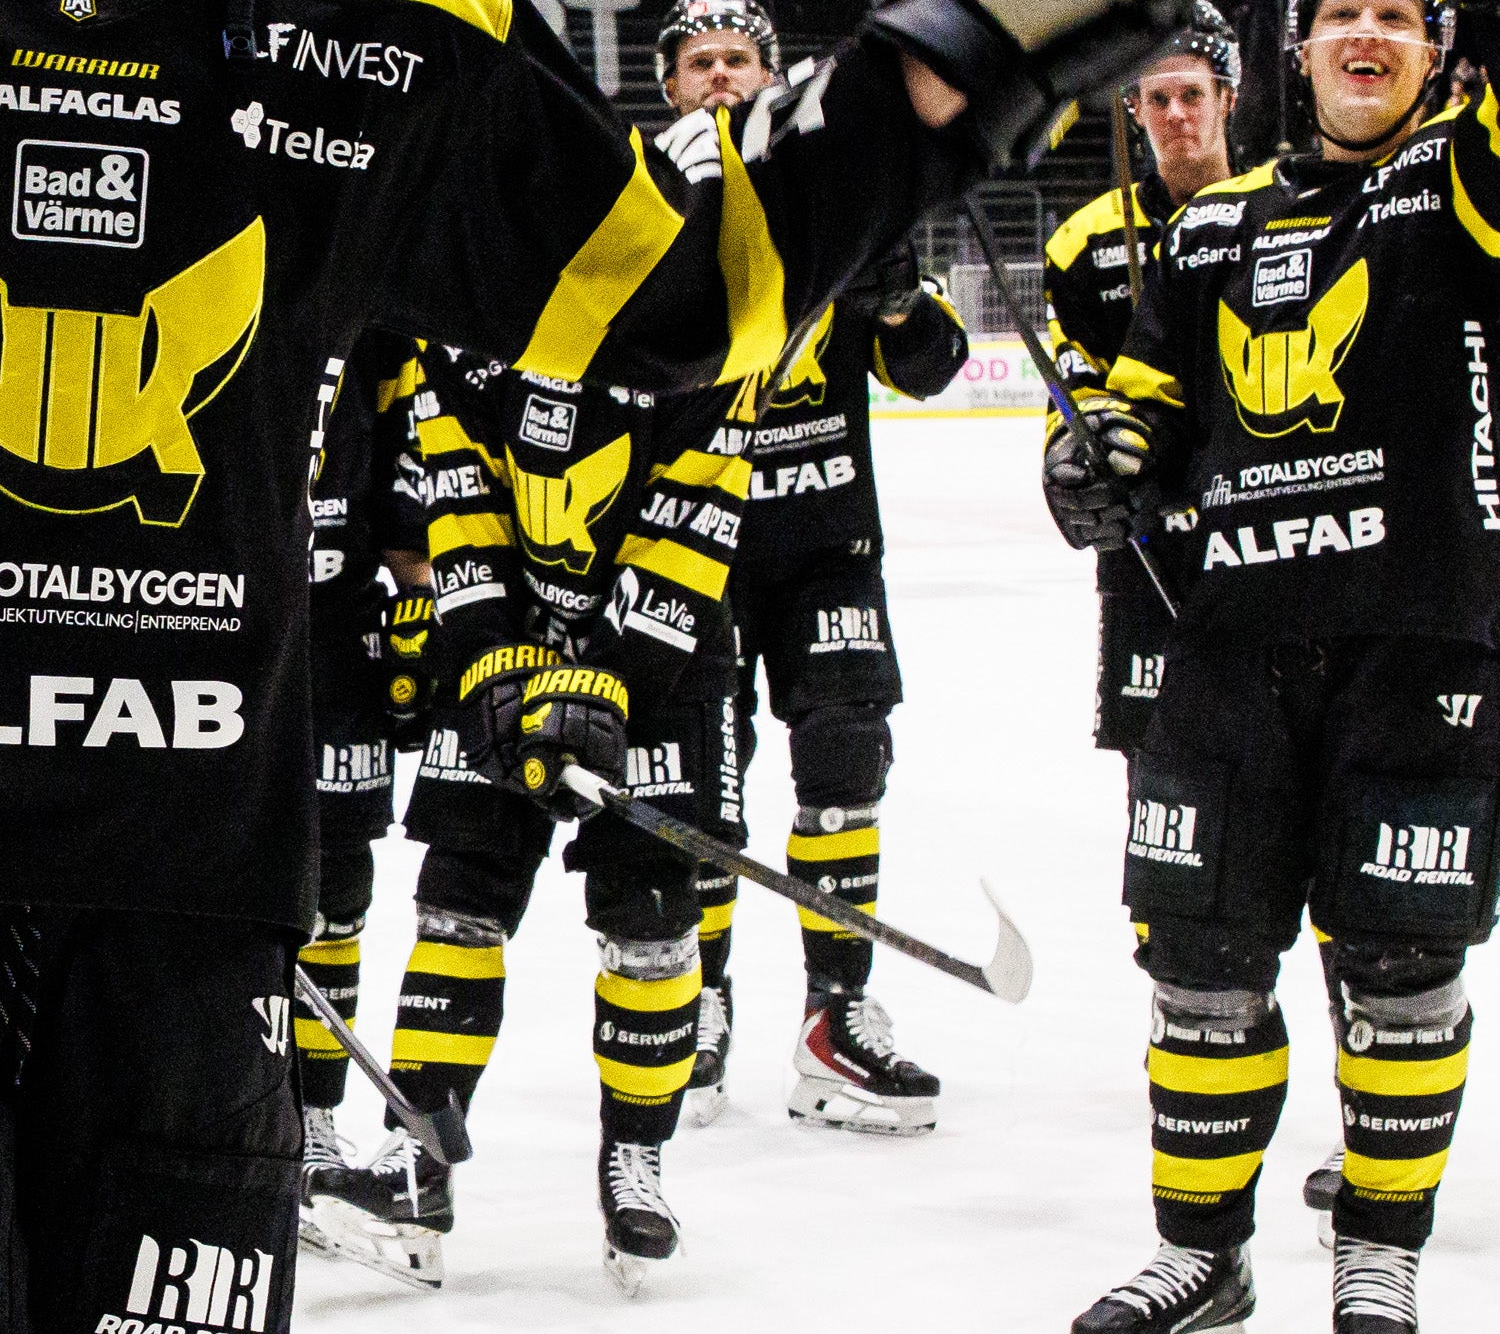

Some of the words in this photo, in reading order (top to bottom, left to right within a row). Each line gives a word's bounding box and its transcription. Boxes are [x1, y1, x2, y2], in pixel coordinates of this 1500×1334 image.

[10, 47, 161, 81] WARRIOR
[293, 28, 426, 94] INVEST
[24, 165, 91, 199] Bad
[23, 196, 137, 238] Värme
[1256, 276, 1307, 303] Värme
[1238, 448, 1385, 487] TOTALBYGGEN
[1203, 506, 1387, 571] ALFAB
[436, 559, 495, 595] LaVie
[641, 588, 698, 632] LaVie
[1359, 861, 1413, 884] ROAD
[1414, 869, 1475, 886] RENTAL
[615, 1020, 694, 1047] SERWENT
[1156, 1112, 1251, 1135] SERWENT
[1359, 1111, 1455, 1133] SERWENT
